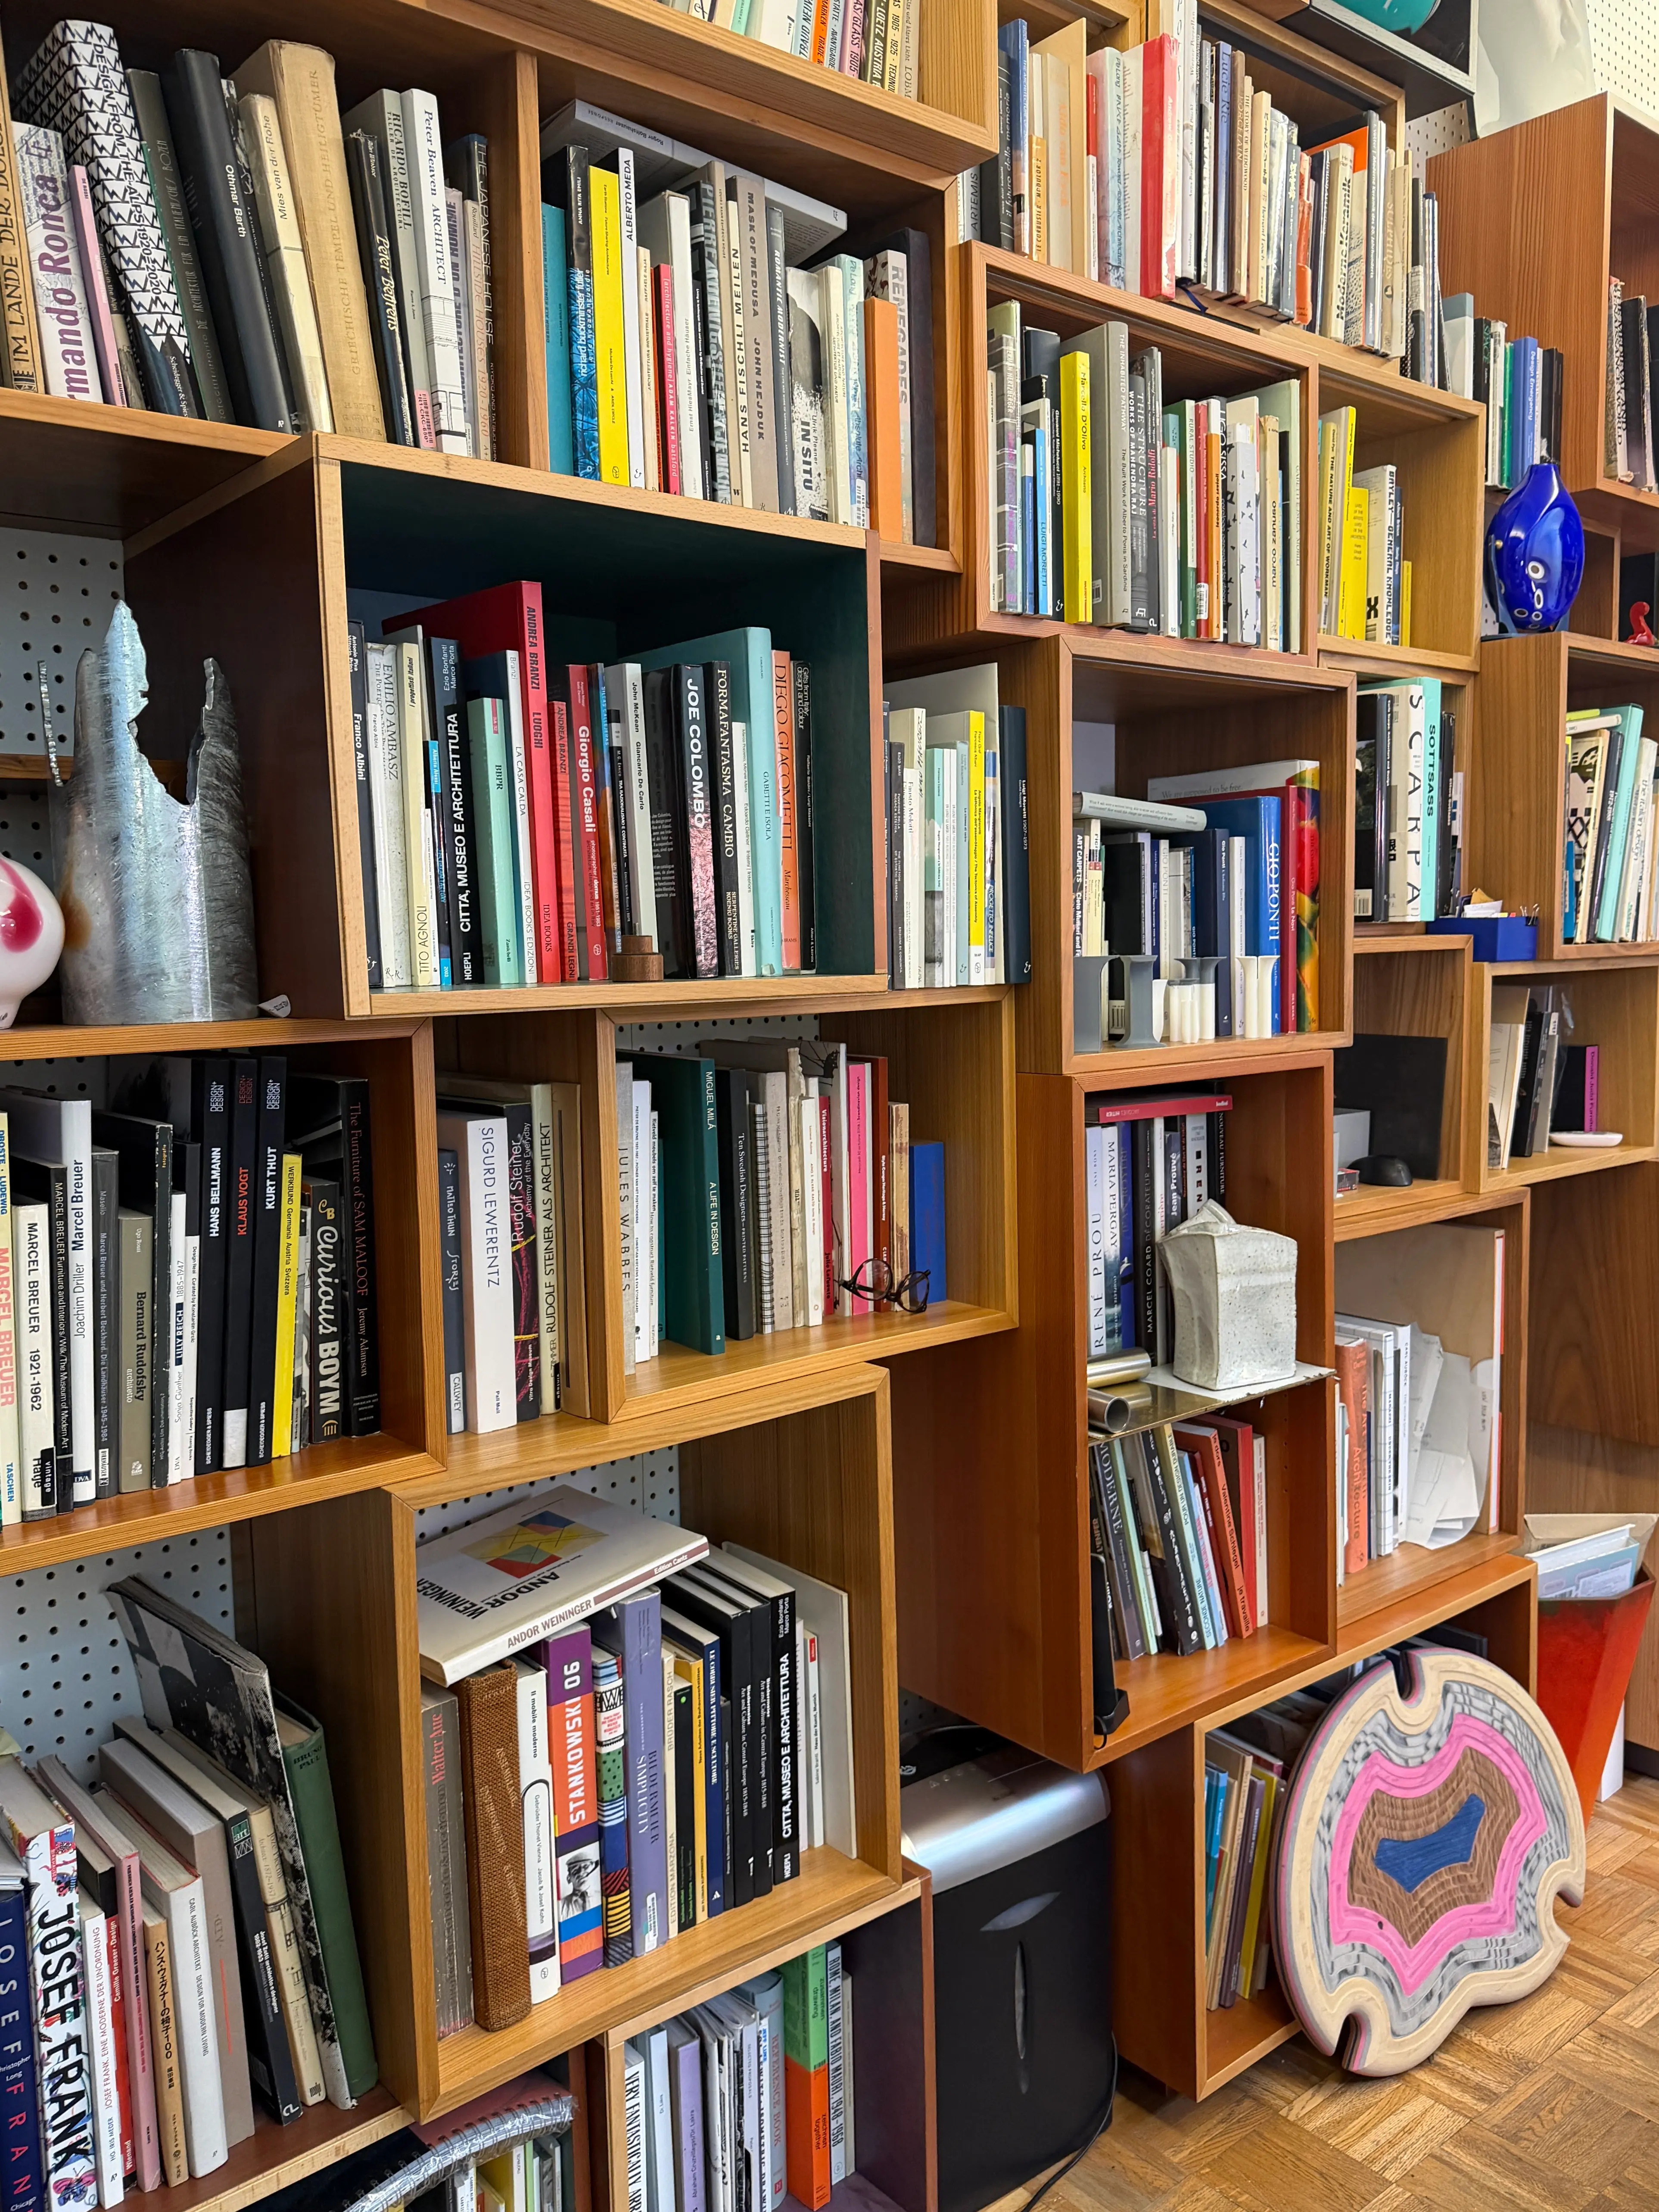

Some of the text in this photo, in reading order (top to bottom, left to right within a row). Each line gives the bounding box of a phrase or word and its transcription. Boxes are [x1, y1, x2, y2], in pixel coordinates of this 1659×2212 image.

[873, 6, 886, 82] LOETZ AUSTRIA
[92, 43, 115, 100] DESIGN
[107, 103, 126, 148] FROM
[118, 151, 135, 183] THE
[127, 186, 145, 226] ALPS
[264, 116, 287, 219] Mies van der Rohe
[392, 113, 412, 230] RICARDO BOFILL
[35, 174, 72, 276] Ronca
[225, 165, 247, 237] Othmar Barth
[424, 109, 447, 284] Peter Beaven ARCHITECT
[0, 196, 29, 362] IM LANDE DER
[377, 235, 397, 331] Peter Behrens
[477, 143, 494, 345] THE JAPANESE HOUSE
[750, 234, 756, 254] OF
[750, 258, 759, 317] MEDUSA
[774, 249, 782, 303] ROMANTIC
[732, 249, 750, 453] HANS FISCHLI MEILEN
[777, 304, 785, 365] MODERNIST
[755, 377, 764, 440] HEJDUK
[800, 420, 813, 491] IN SITU
[1148, 449, 1156, 479] Ridolfi
[1148, 481, 1156, 507] Mario
[383, 664, 399, 781] EMILIO AMBASZ
[526, 606, 543, 749] ANDREA BRANZI LUOGHI
[354, 714, 366, 781] Franco Albini
[447, 713, 465, 821] ARCHITETTURA
[579, 725, 596, 833] Giorgio Casali
[638, 778, 642, 789] De
[687, 678, 705, 828] JOE COLOMBO
[718, 669, 734, 857] FORMAFANTASMA CAMBIO
[775, 665, 792, 850] DIEGO GIACOMETTI
[1427, 725, 1436, 817] SOTTSASS
[454, 823, 464, 833] E
[454, 836, 467, 887] MUSEO
[1269, 843, 1279, 941] GIO PONTI
[417, 906, 429, 974] TITO AGNOLI
[210, 1147, 221, 1237] HANS BELLMANN
[237, 1167, 249, 1235] KLAUS VOGT
[266, 1146, 277, 1209] KURT THUT
[481, 1127, 500, 1288] SIGURD LEWERENTZ
[618, 1147, 630, 1291] JULES WABBES
[72, 1160, 85, 1338] Joachim Driller Marcel Breuer
[539, 1123, 557, 1334] RUDOLF STEINER ALS ARCHITEKT
[27, 1223, 41, 1411] MARCEL BREUER 1921-1962
[317, 1226, 340, 1416] Curious BOYM
[1091, 1212, 1104, 1348] RENÉ PROU
[137, 1291, 146, 1402] Bernard Rudofsky
[452, 1377, 461, 1412] CALLWEY
[6, 1463, 14, 1503] TASCHEN
[1099, 1442, 1123, 1534] MODERNE
[1221, 1484, 1240, 1569] Valentine Schlegel
[507, 1600, 592, 1649] ANDOR WEININGER
[563, 1660, 586, 1824] STANKOWSKI 06
[829, 1956, 840, 1984] ROME,
[829, 1985, 841, 2019] MILAN,
[38, 1903, 90, 2172] JOSEF FRANK
[830, 2020, 841, 2037] AND
[830, 2037, 842, 2065] FABIO
[831, 2065, 843, 2098] MAURI,
[625, 2071, 641, 2186] VERY FANTASTICALLY
